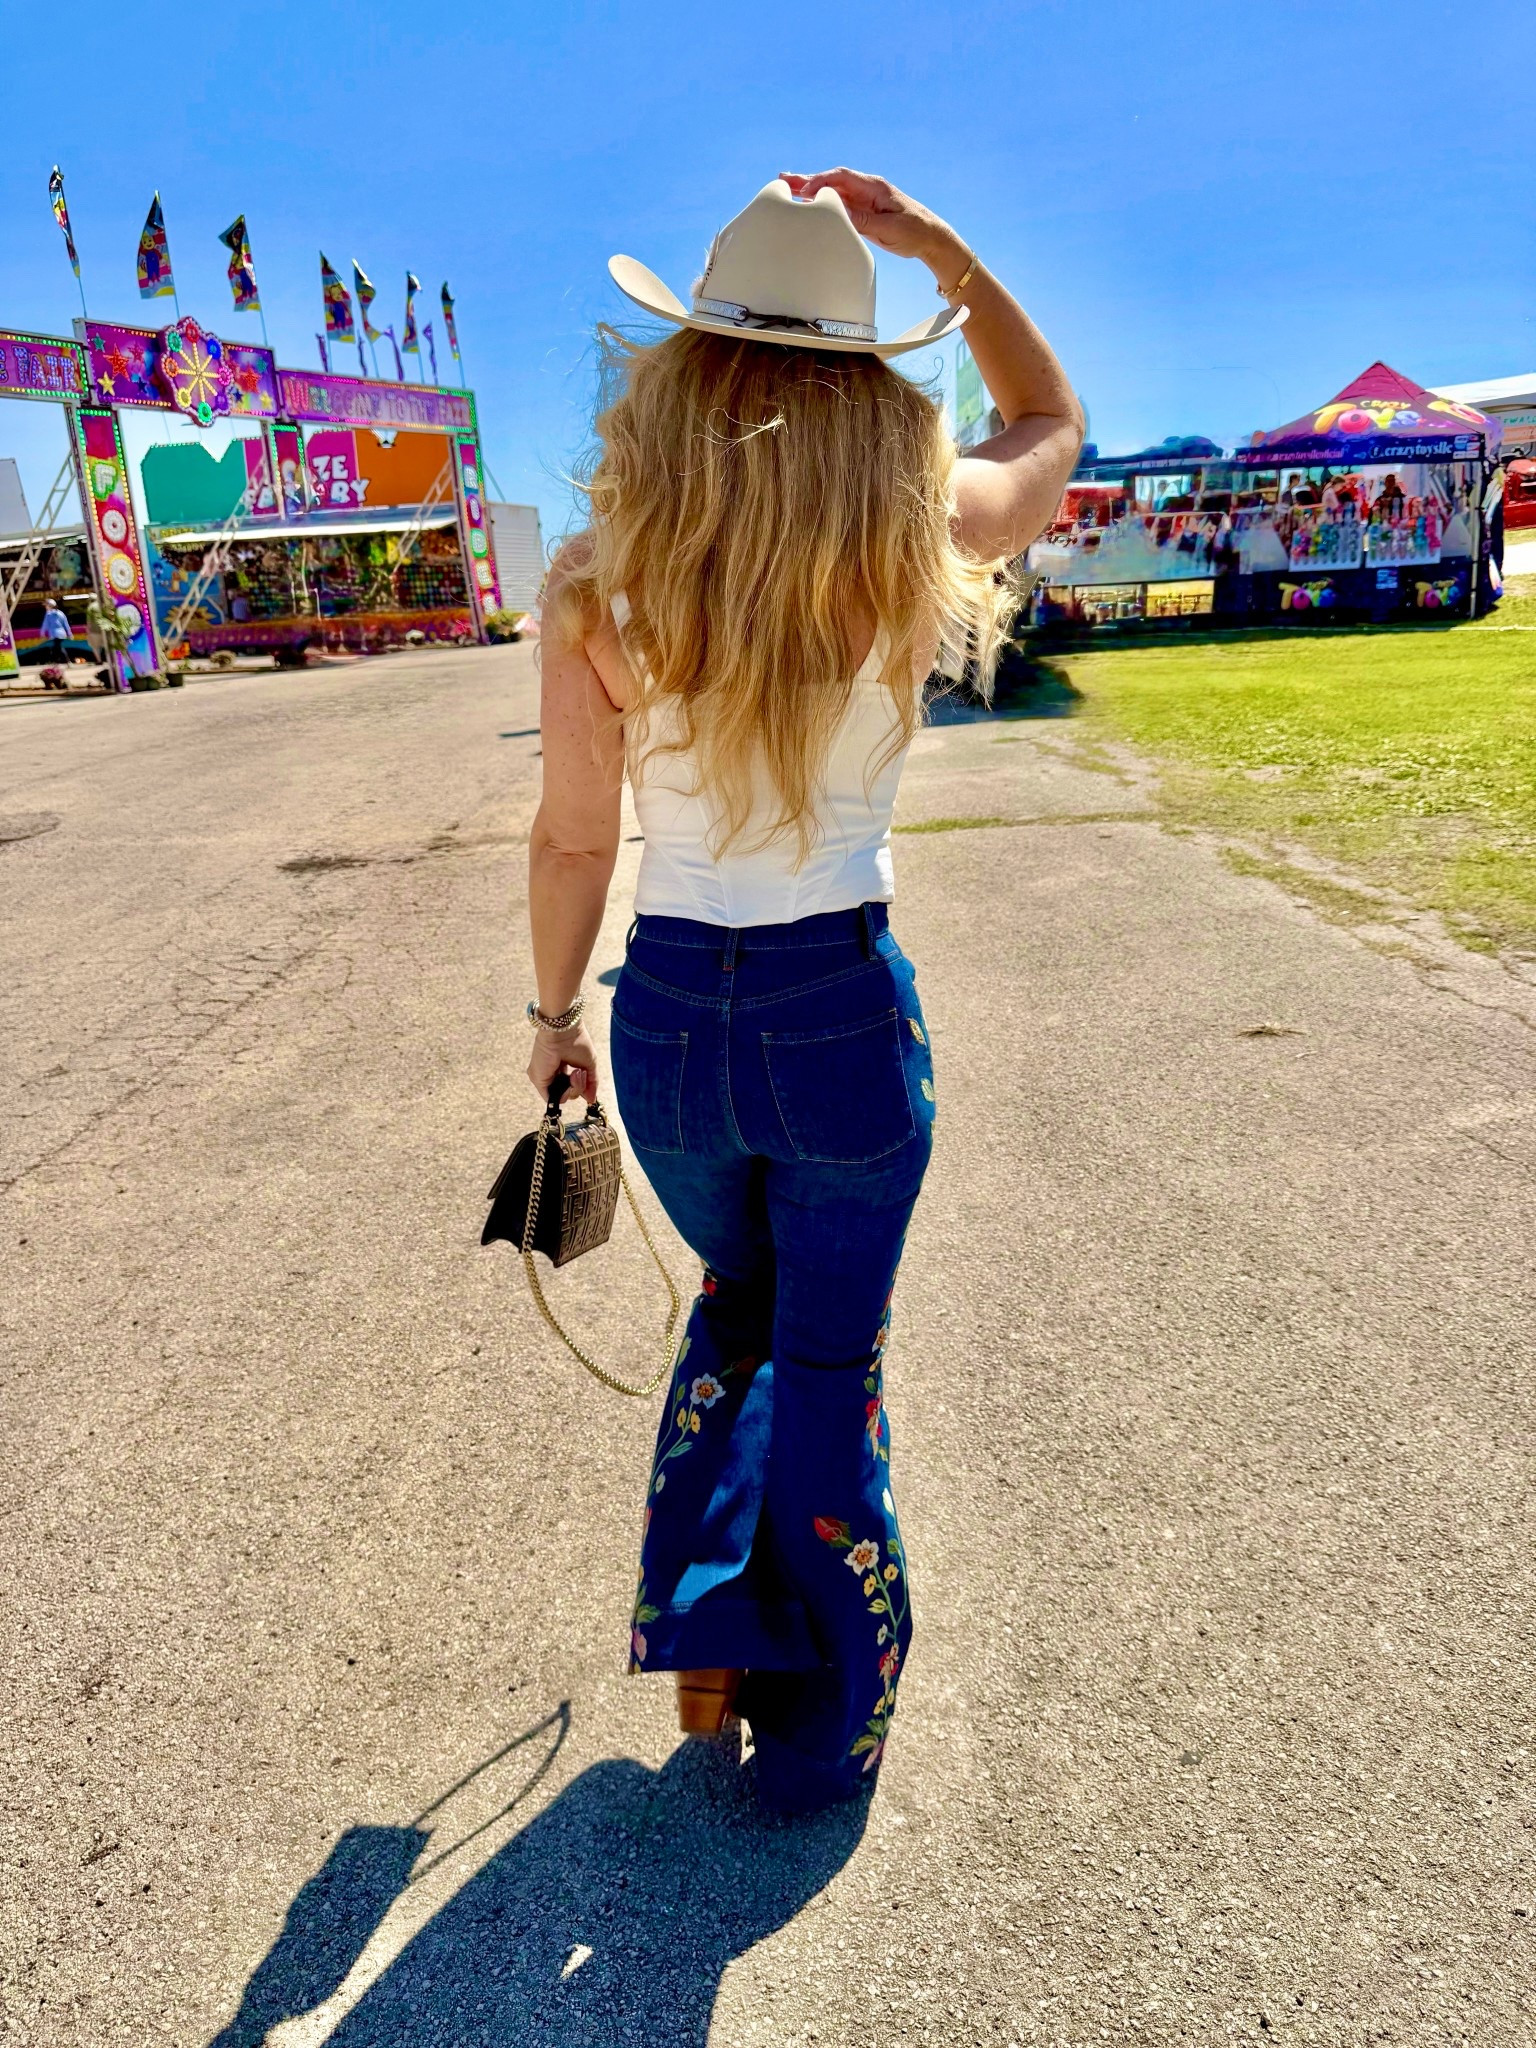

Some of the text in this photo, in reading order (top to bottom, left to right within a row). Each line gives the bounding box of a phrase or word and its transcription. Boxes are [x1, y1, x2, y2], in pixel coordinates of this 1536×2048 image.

[12, 345, 77, 389] FAIR
[286, 378, 381, 417] WELCOME
[1312, 403, 1422, 435] TOYS
